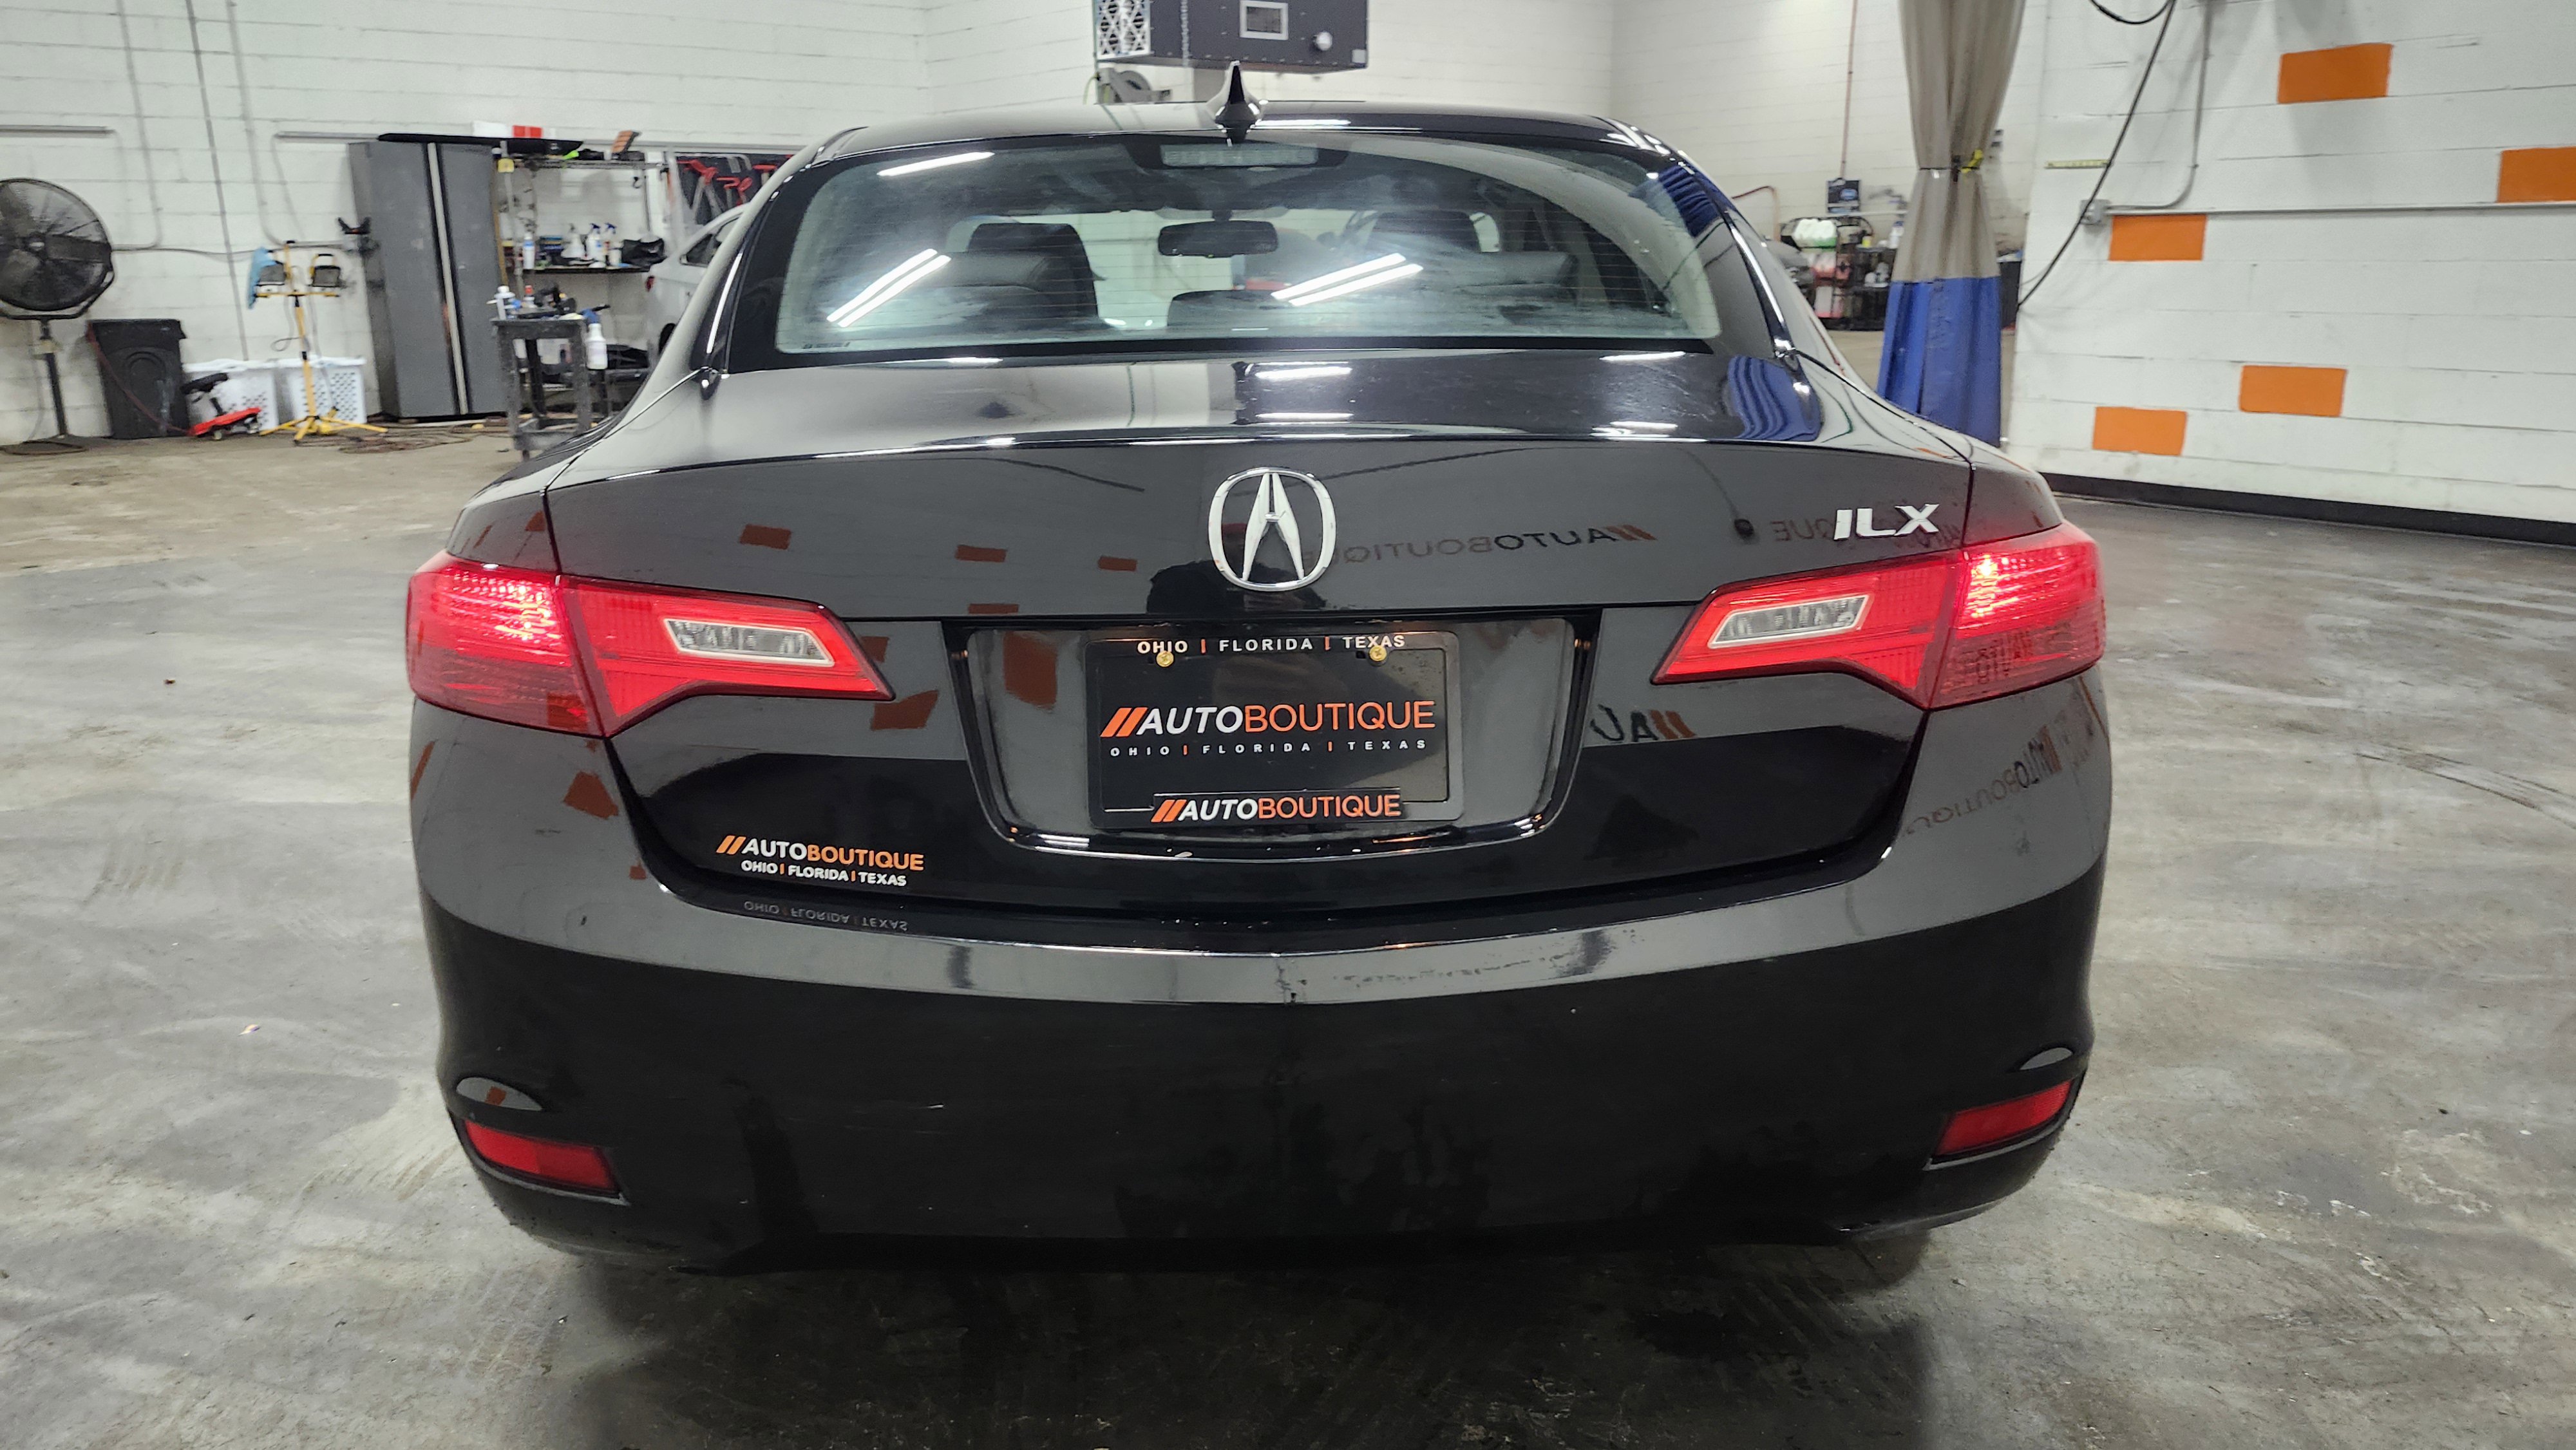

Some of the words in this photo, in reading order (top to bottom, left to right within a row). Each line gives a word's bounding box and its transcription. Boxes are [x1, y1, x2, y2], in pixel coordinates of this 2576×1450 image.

[1834, 504, 1939, 540] ILX
[1137, 640, 1188, 654] OHIO
[1219, 637, 1313, 652] FLORIDA
[1342, 635, 1405, 649] TEXAS
[1136, 700, 1435, 735] AUTOBOUTIQUE
[1110, 746, 1170, 757] OHIO
[1202, 742, 1311, 755] FLORIDA
[1347, 739, 1426, 751] TEXAS
[1178, 794, 1401, 822] AUTOBOUTIQUE
[741, 838, 925, 871] AUTOBOUTIQUE
[741, 860, 779, 874] OHIO
[788, 865, 849, 881] FLORIDA
[858, 871, 907, 887] TEXAS
